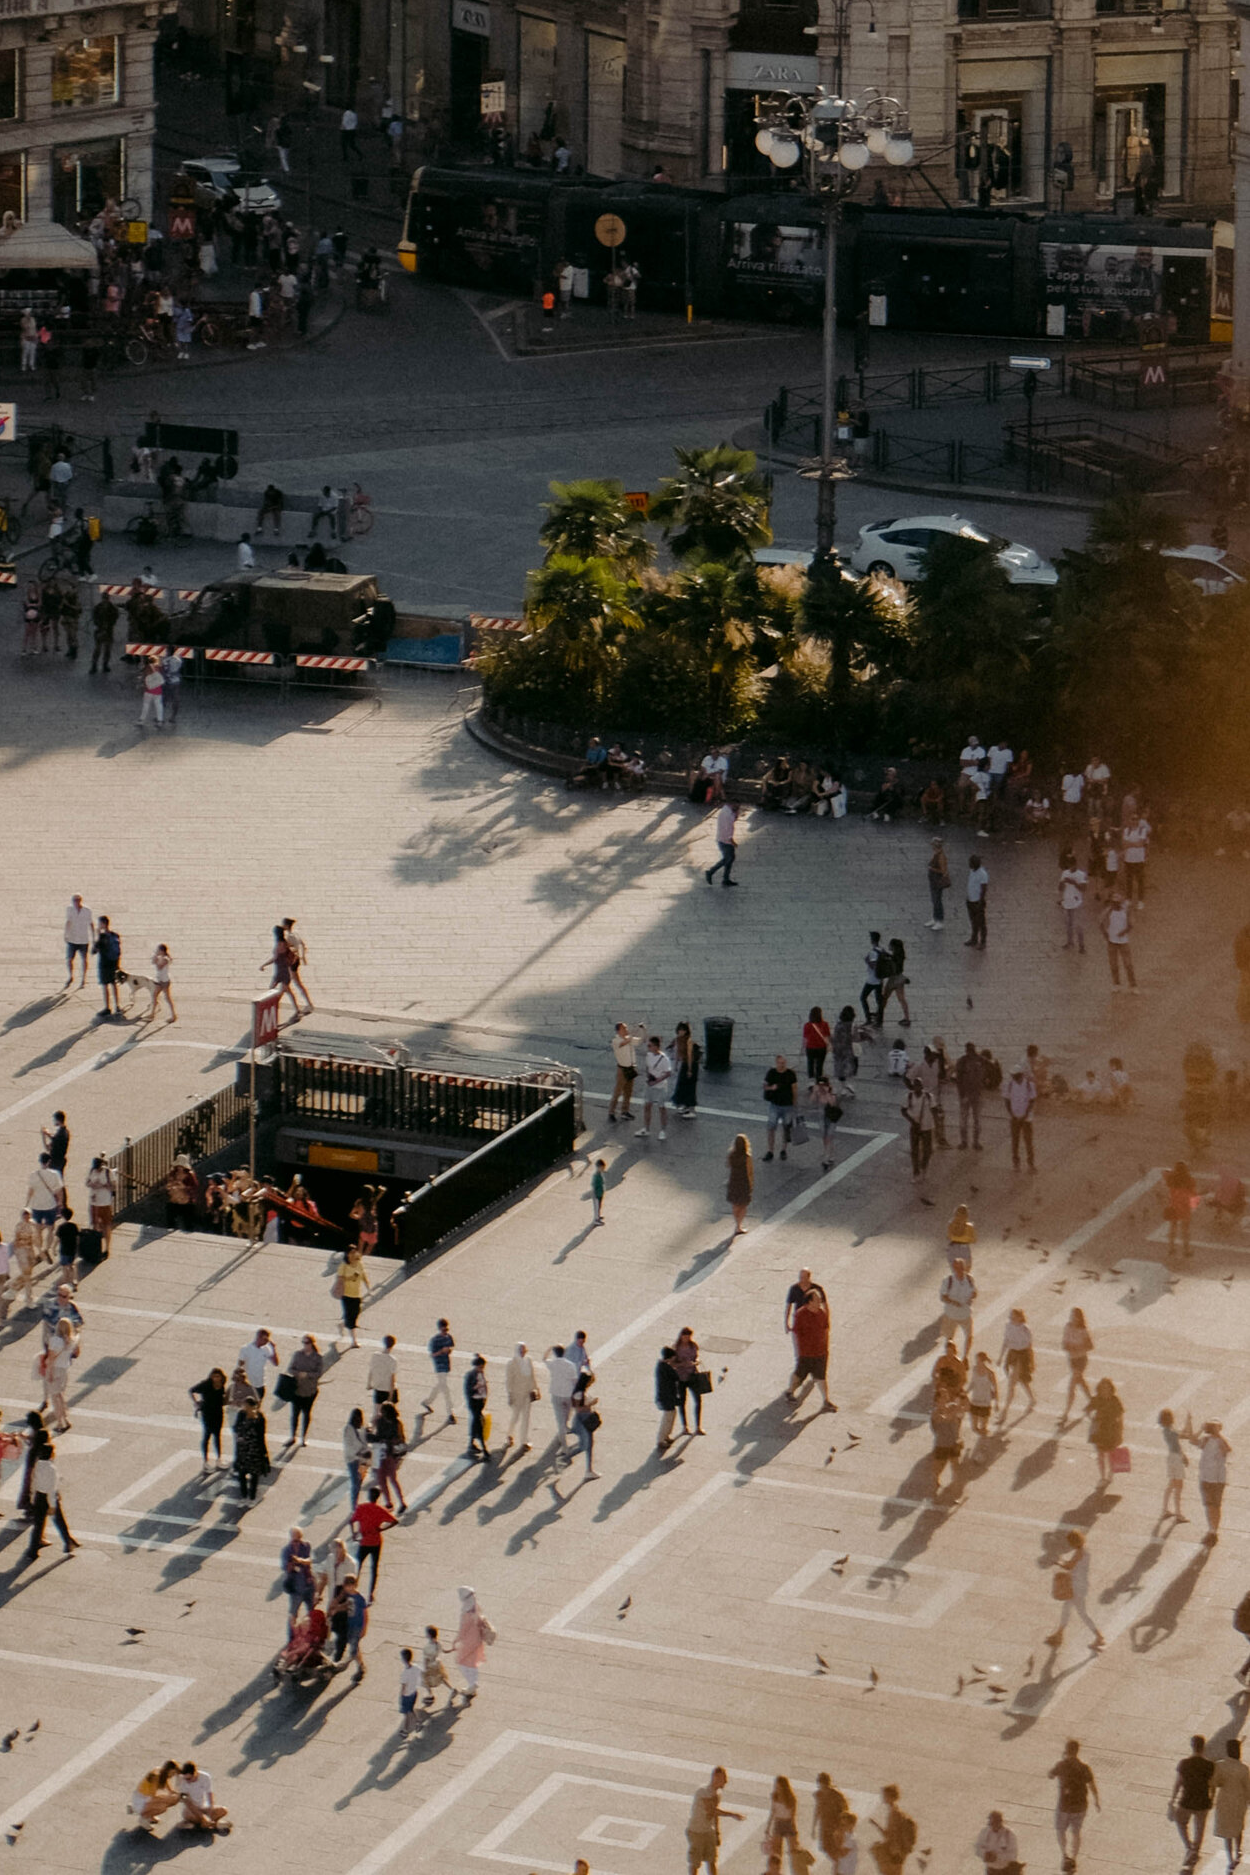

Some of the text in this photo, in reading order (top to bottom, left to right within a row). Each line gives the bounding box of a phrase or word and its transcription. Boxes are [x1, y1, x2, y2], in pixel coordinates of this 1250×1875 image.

[754, 65, 802, 82] ZARA
[172, 217, 193, 234] M
[726, 257, 827, 276] Arriva rilassato.
[1144, 366, 1165, 384] M
[260, 1005, 277, 1036] M
